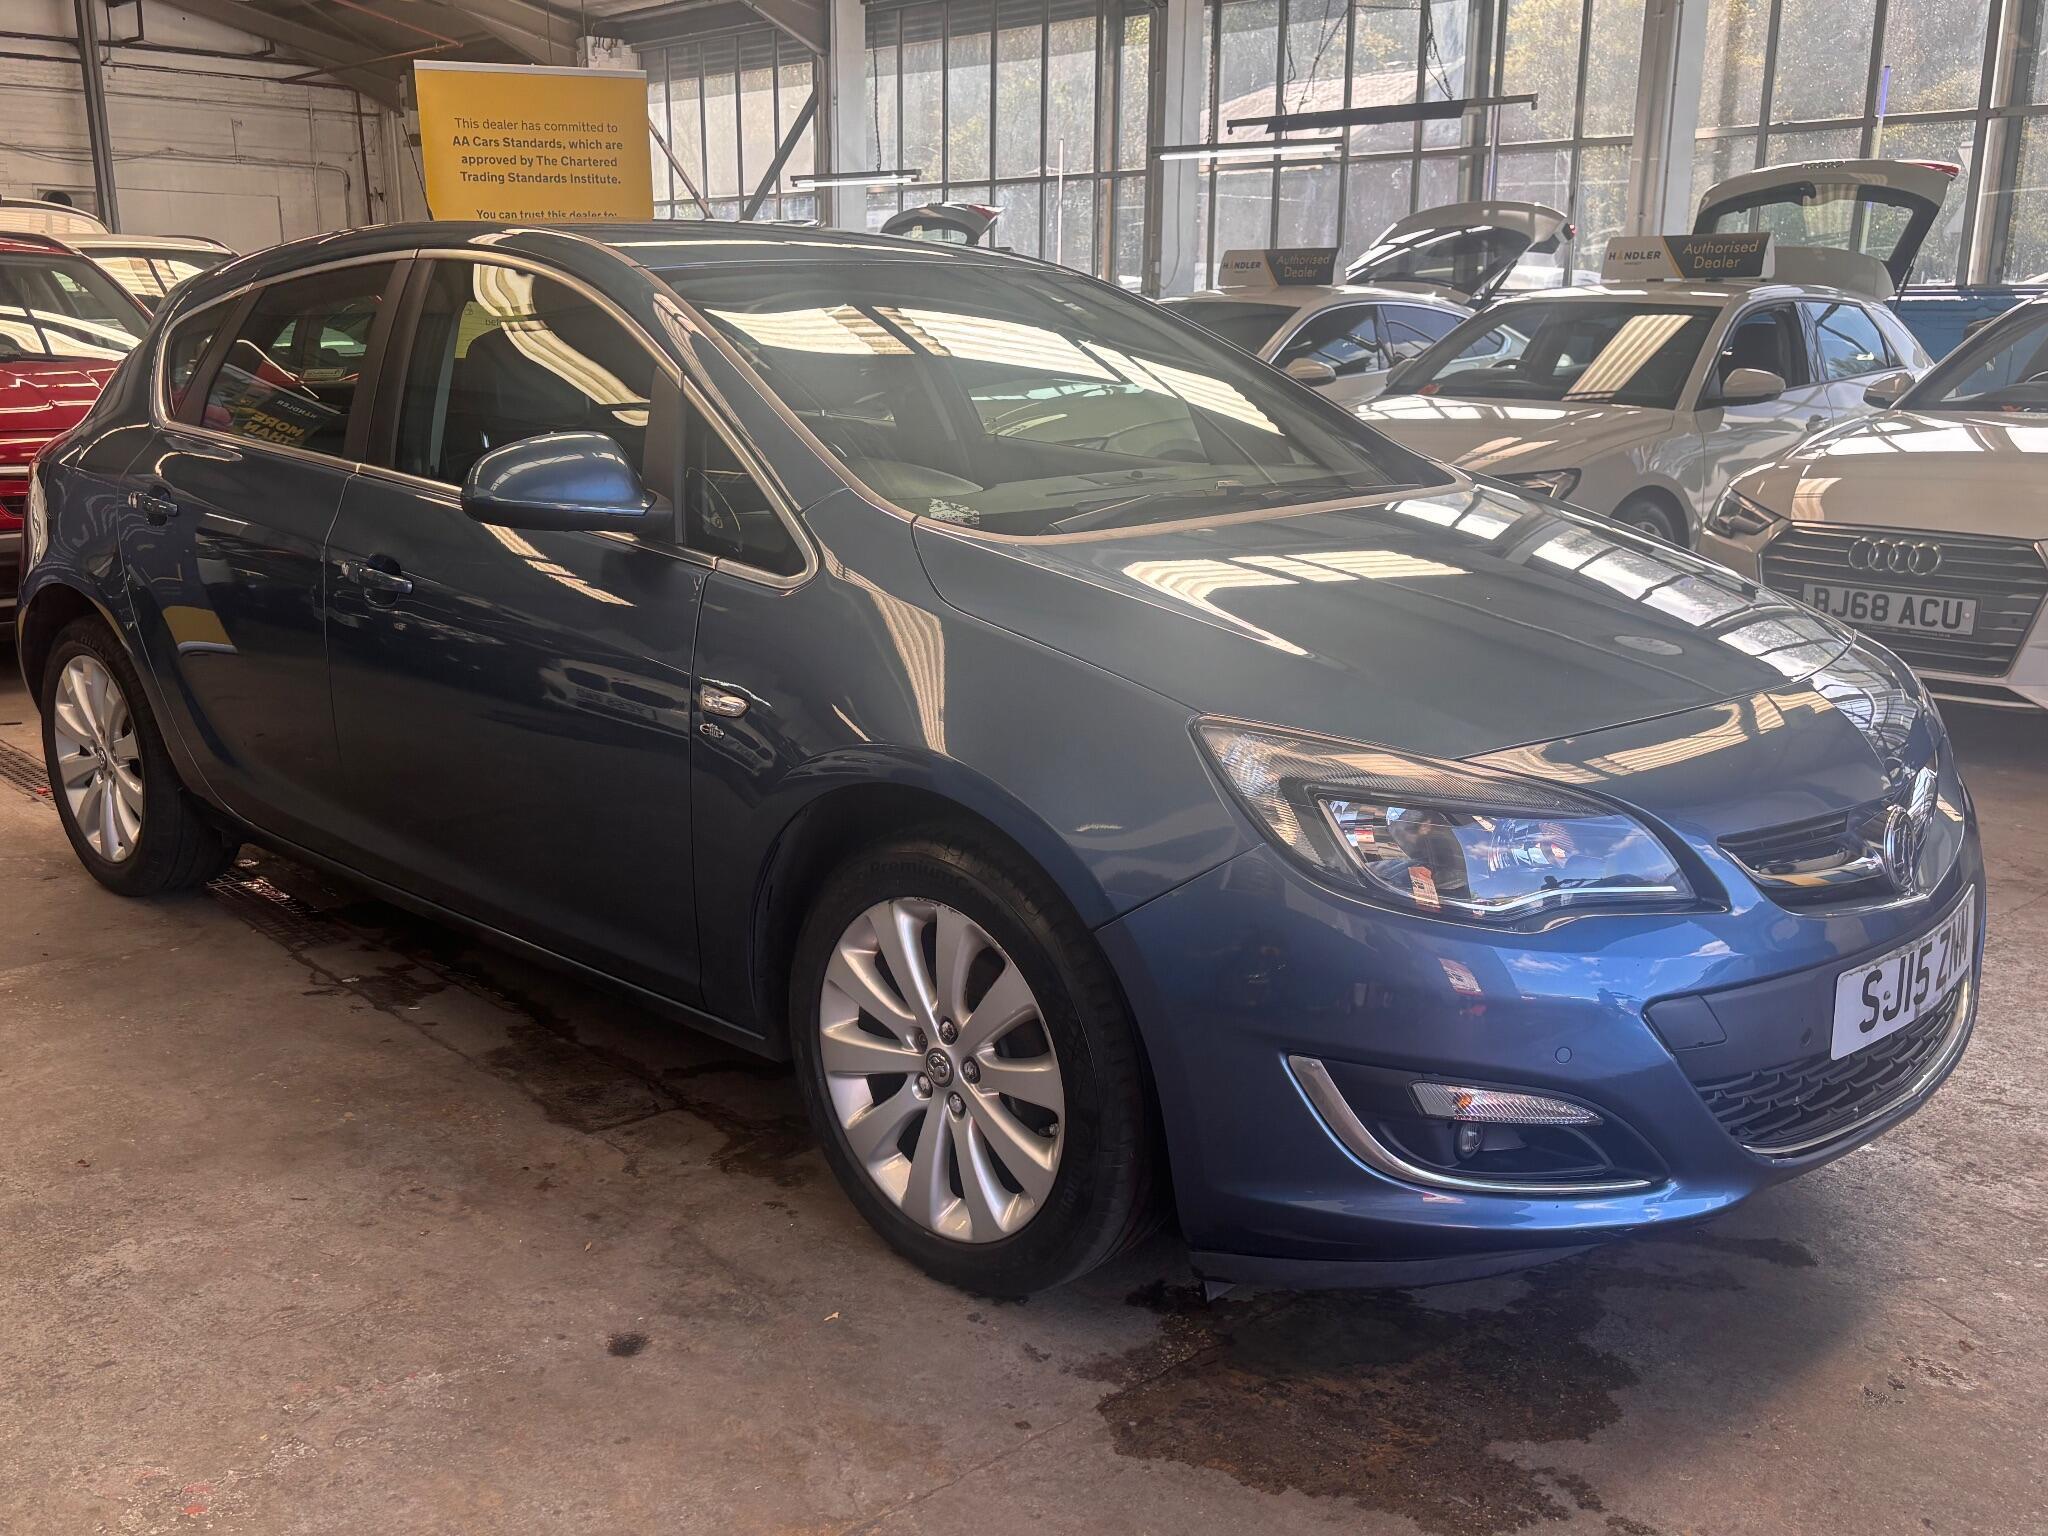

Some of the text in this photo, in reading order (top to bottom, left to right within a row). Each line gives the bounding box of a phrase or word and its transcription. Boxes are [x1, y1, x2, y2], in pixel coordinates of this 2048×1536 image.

[454, 117, 618, 133] This dealer has committed to
[452, 136, 623, 150] AA Cars Standards, which are
[461, 155, 618, 167] approved by The Chartered
[460, 171, 622, 185] Trading Standards Institute.
[476, 209, 496, 220] You
[498, 210, 518, 219] can
[520, 210, 545, 219] trust
[1683, 240, 1759, 255] Authorised
[1275, 255, 1330, 265] Authorised
[1694, 256, 1741, 269] Dealer
[1284, 266, 1317, 278] Dealer
[1814, 588, 1964, 629] BJ68 ACU
[1859, 941, 1933, 1033] SJ15
